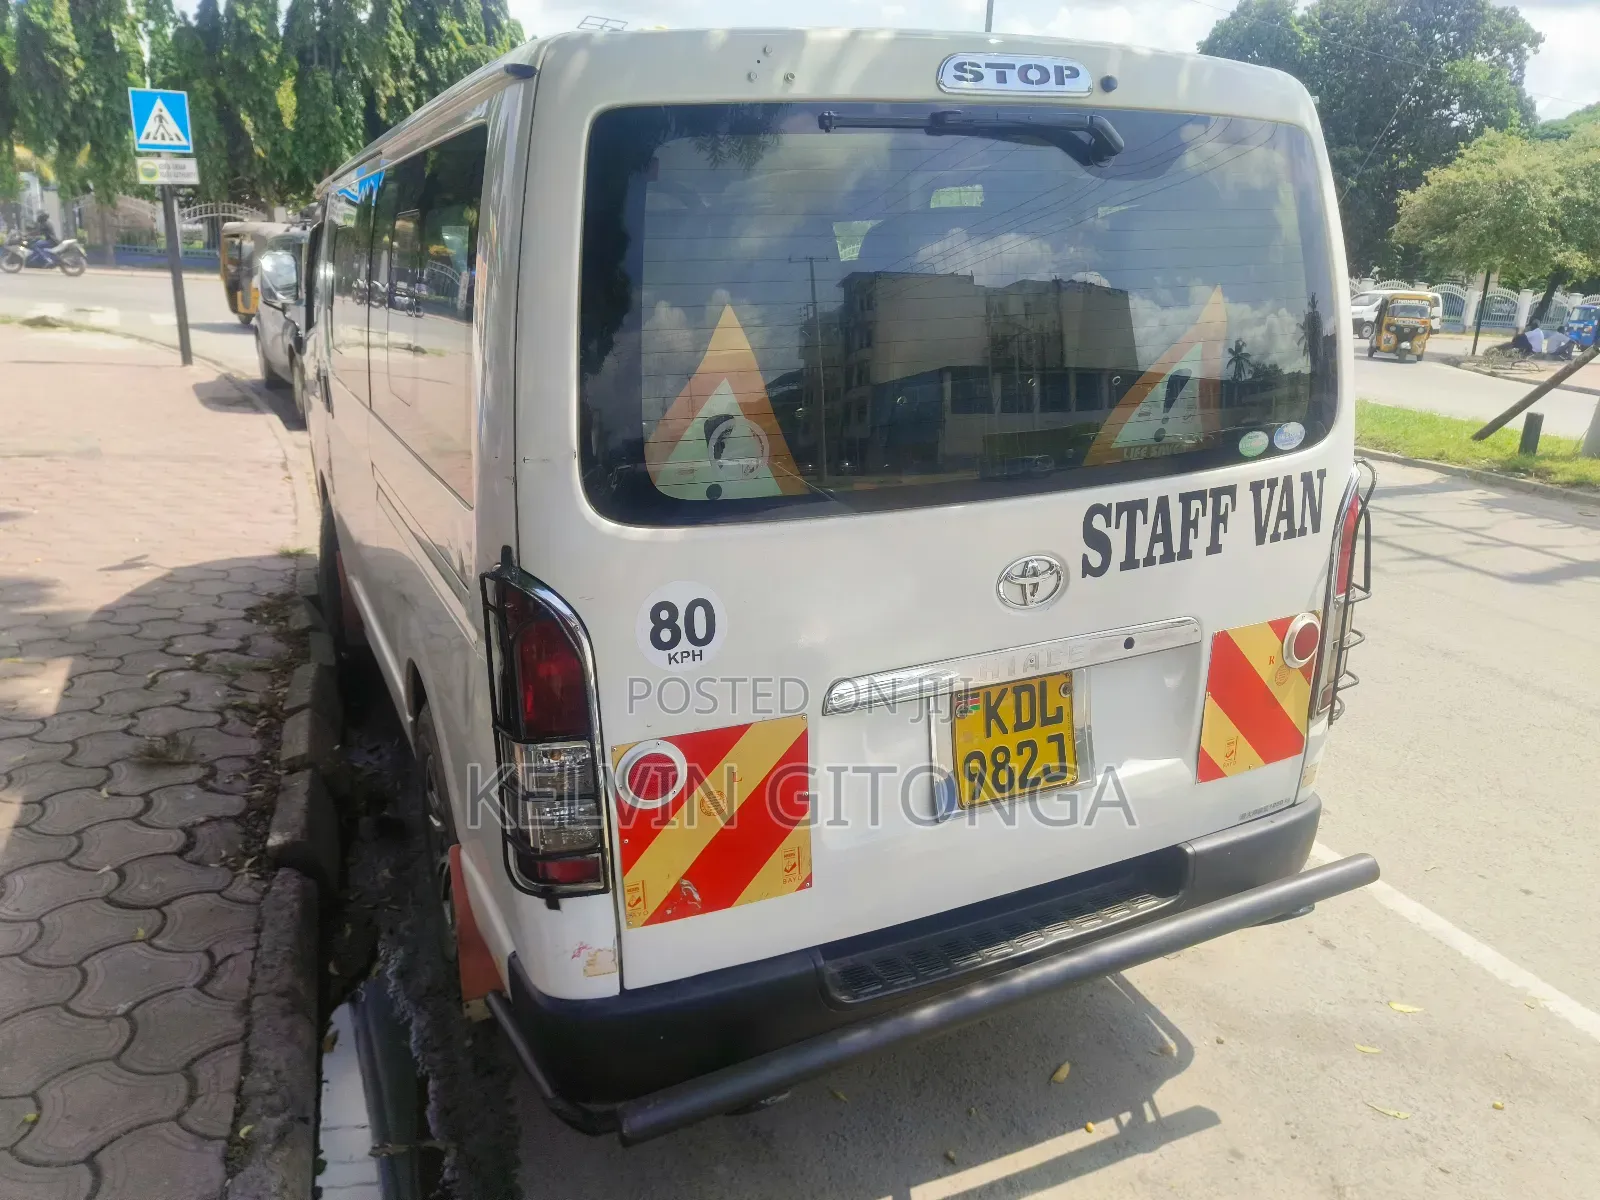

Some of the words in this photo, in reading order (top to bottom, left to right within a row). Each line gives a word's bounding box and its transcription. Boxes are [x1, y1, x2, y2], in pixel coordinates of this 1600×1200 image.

[953, 61, 1080, 86] STOP
[1123, 446, 1148, 459] LIFE
[1081, 484, 1237, 579] STAFF
[1249, 468, 1327, 547] VAN
[649, 597, 716, 651] 80
[667, 649, 703, 665] KPH
[979, 645, 1086, 681] HIACE
[984, 680, 1064, 739] KDL
[731, 771, 743, 783] L
[963, 732, 1067, 801] 982J
[782, 874, 803, 885] BAYO
